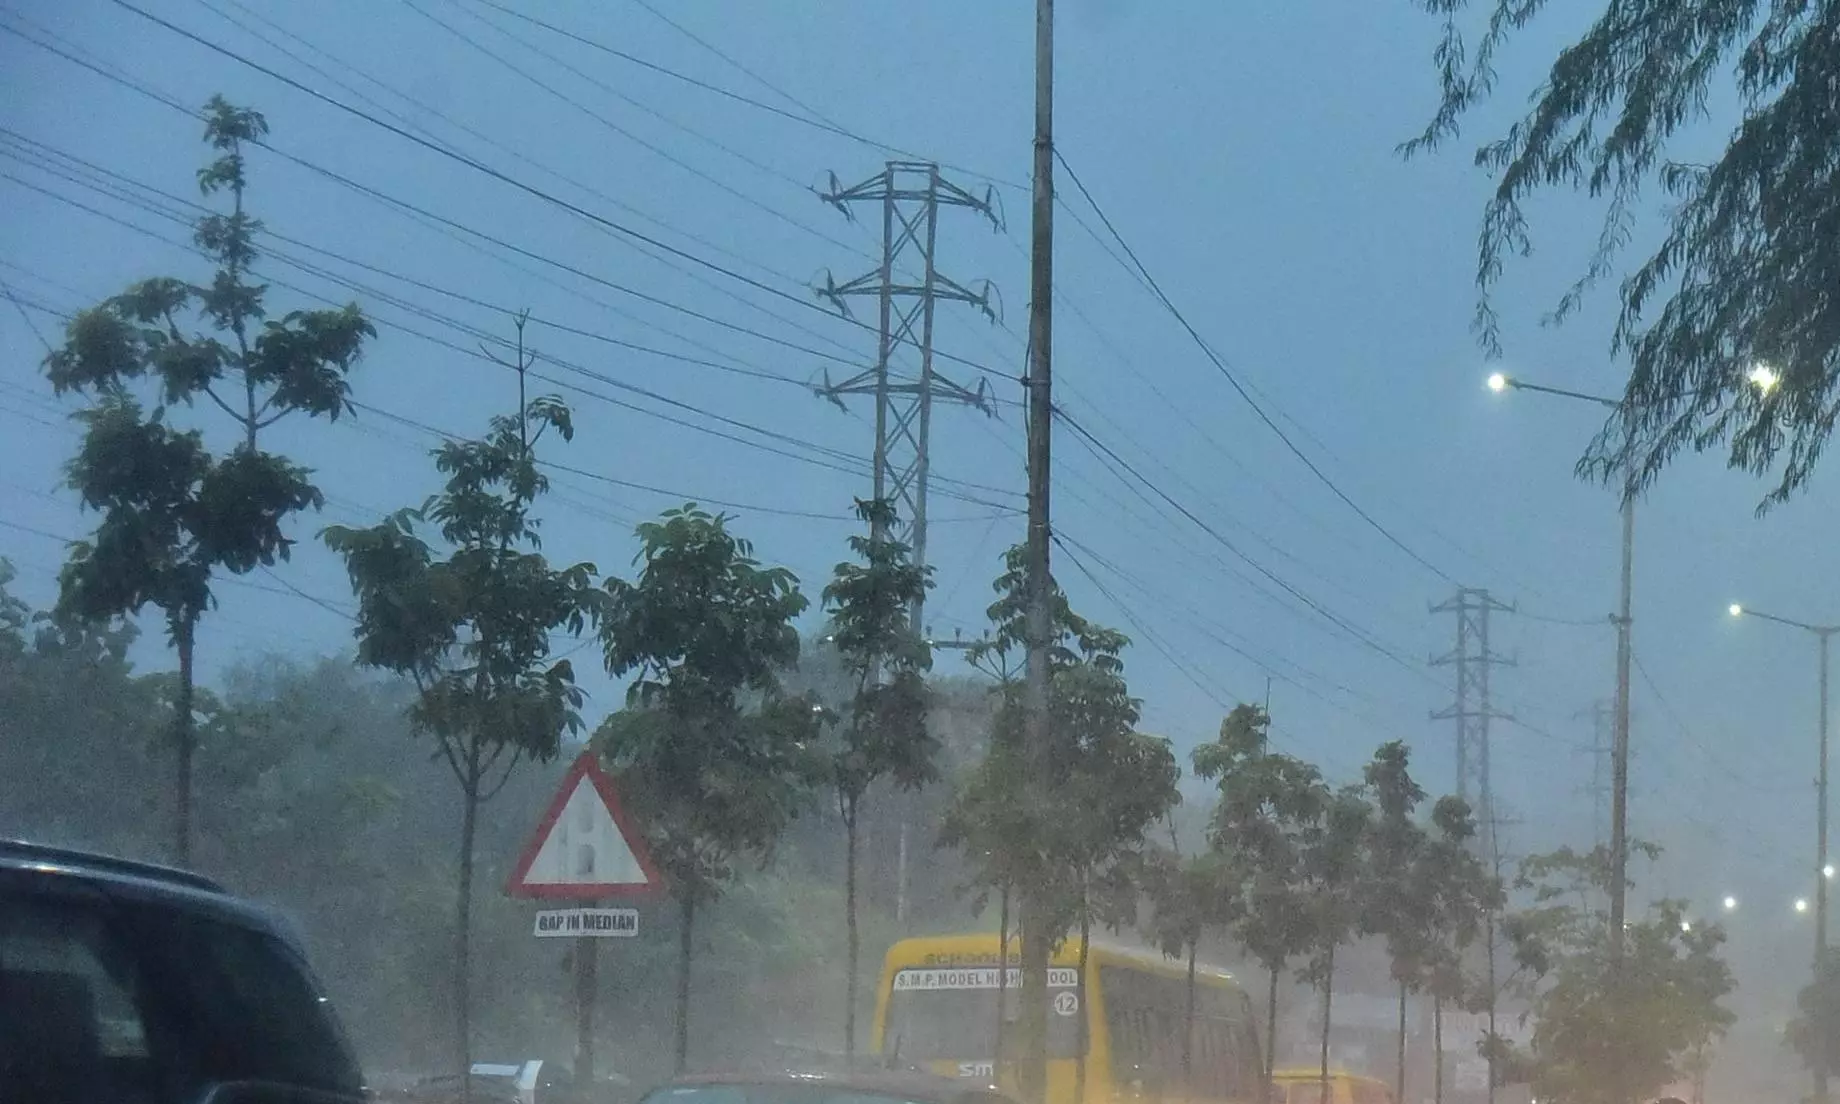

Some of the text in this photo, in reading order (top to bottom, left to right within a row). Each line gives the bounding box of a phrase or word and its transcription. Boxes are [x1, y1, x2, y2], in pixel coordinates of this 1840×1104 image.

[539, 914, 635, 931] GAP IN MEDIAN
[938, 972, 982, 986] MODEL
[1056, 996, 1075, 1011] 12
